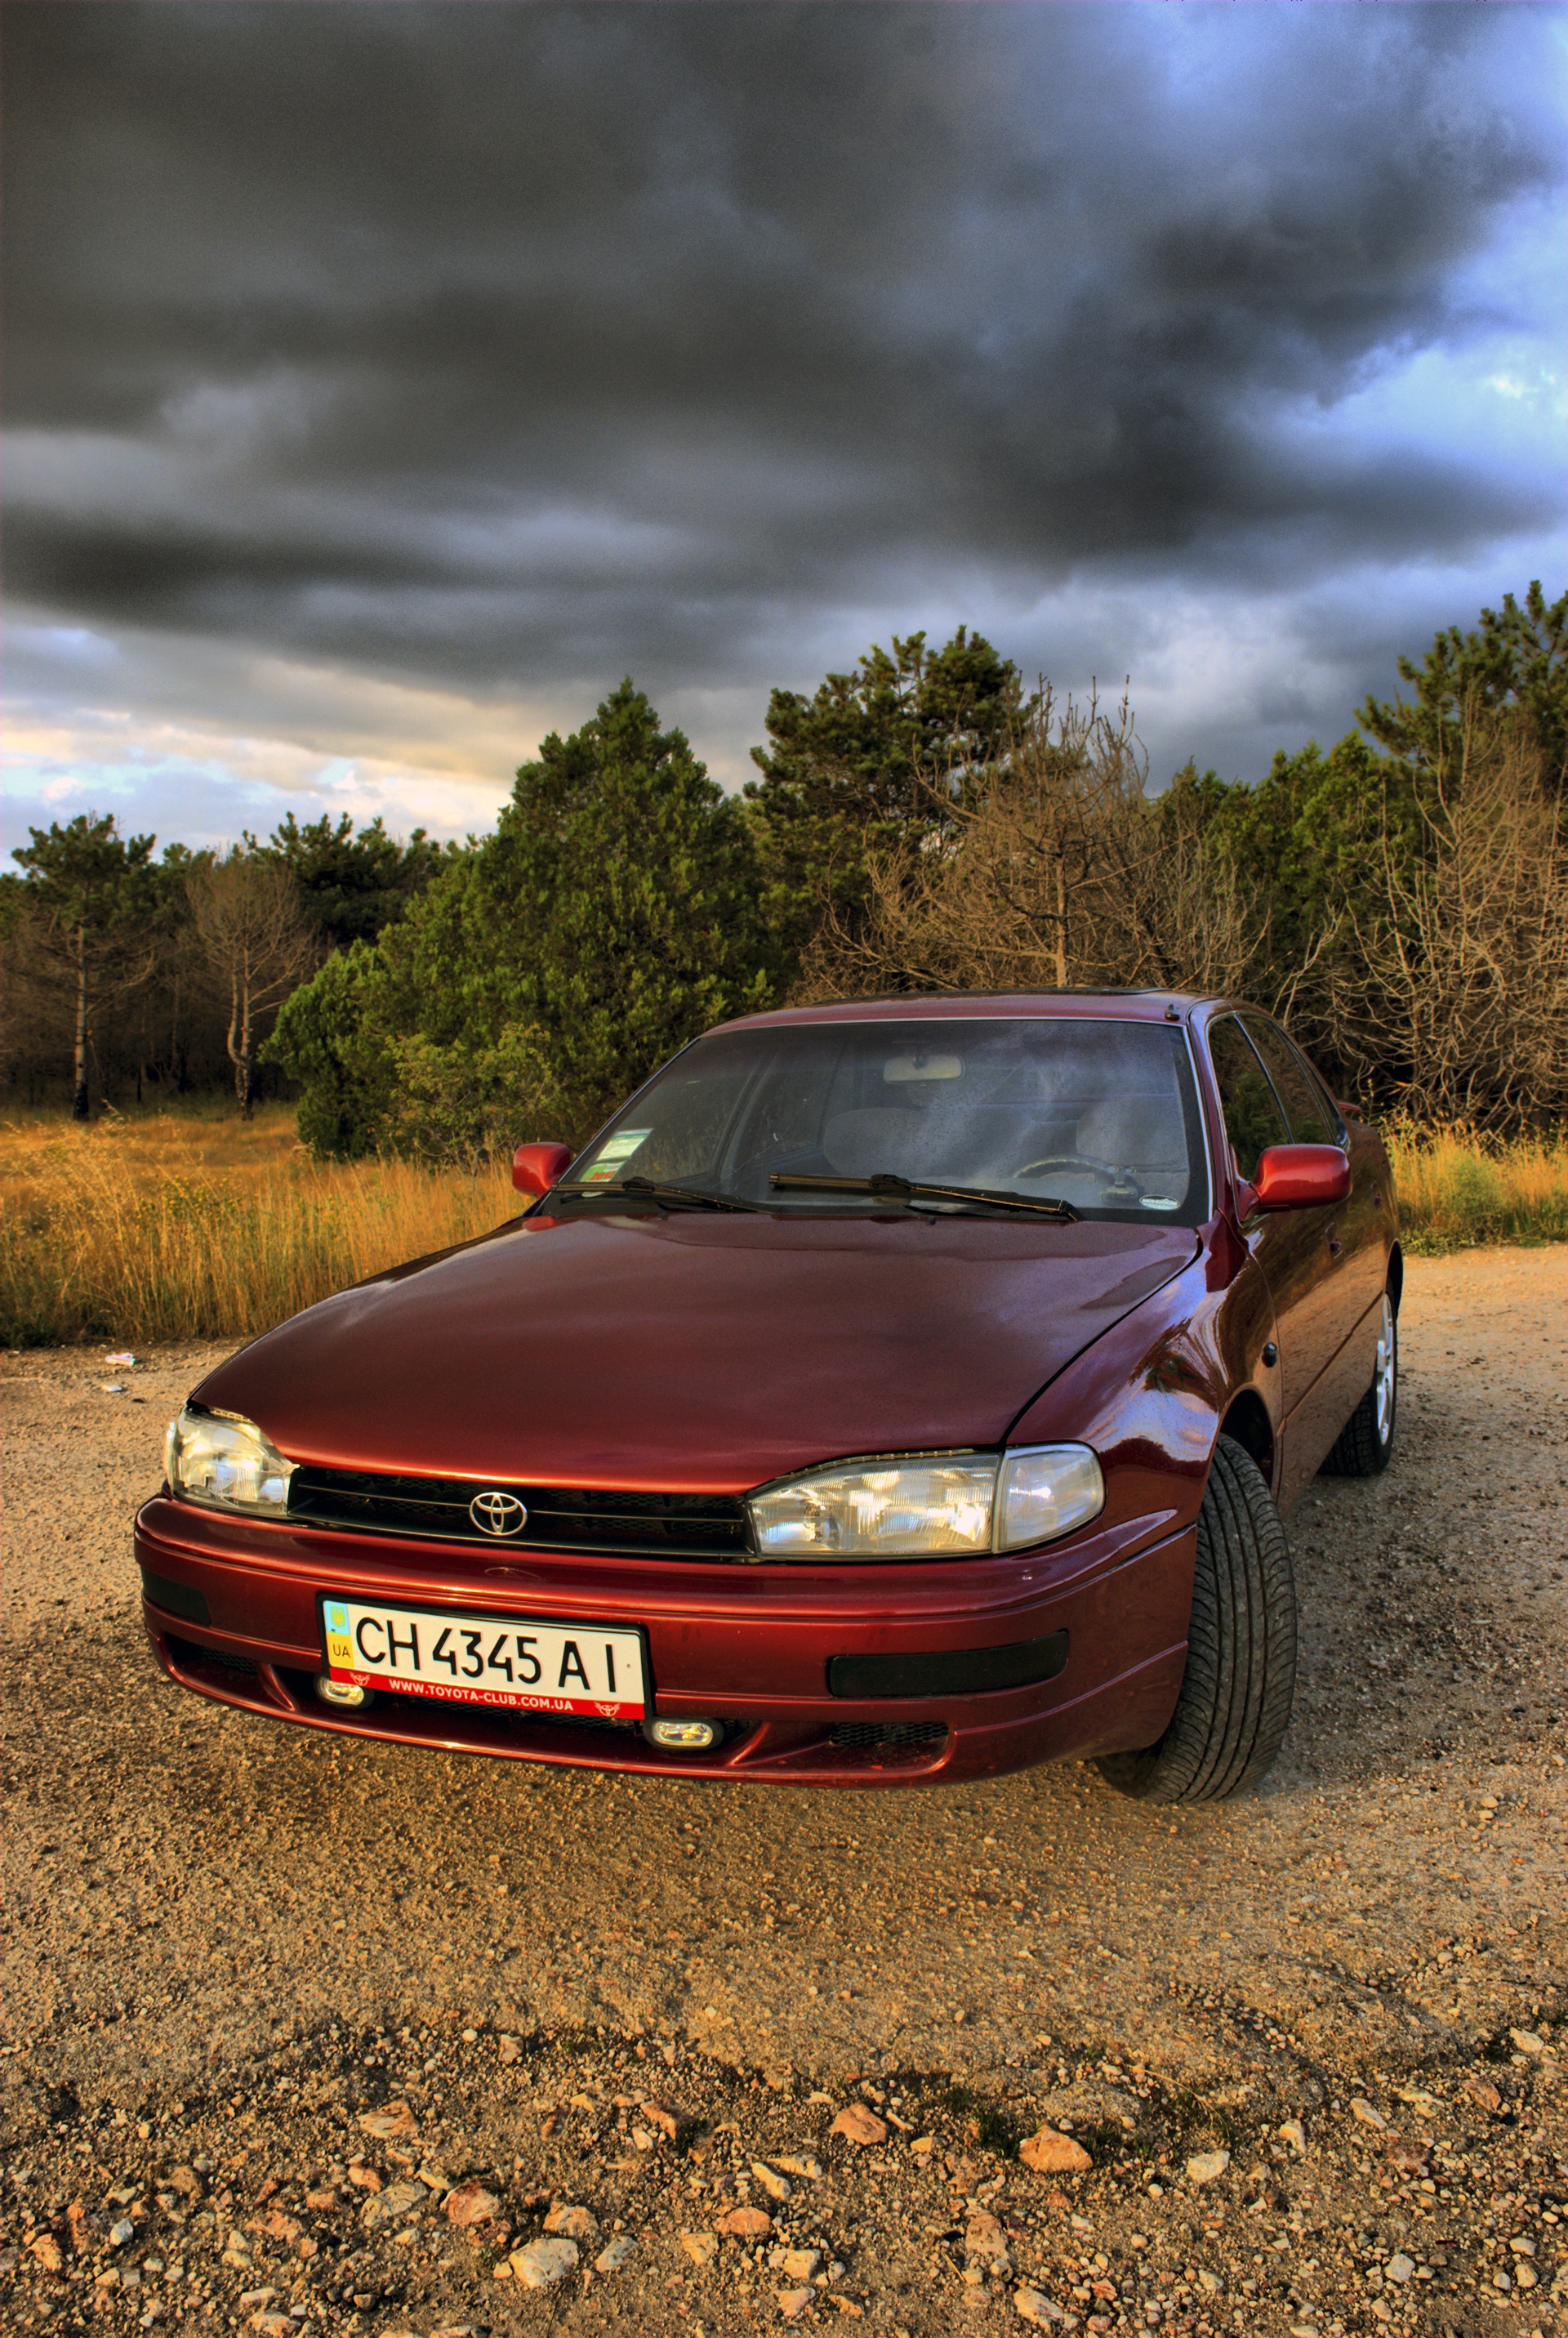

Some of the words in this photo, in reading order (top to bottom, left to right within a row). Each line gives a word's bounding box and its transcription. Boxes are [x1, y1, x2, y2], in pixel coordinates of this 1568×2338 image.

[332, 1644, 350, 1658] UA
[356, 1617, 421, 1671] CH
[432, 1628, 541, 1684] 4345
[558, 1640, 617, 1693] AI
[389, 1679, 573, 1711] WWW.TOYOTA-CLUB.COM.UA
